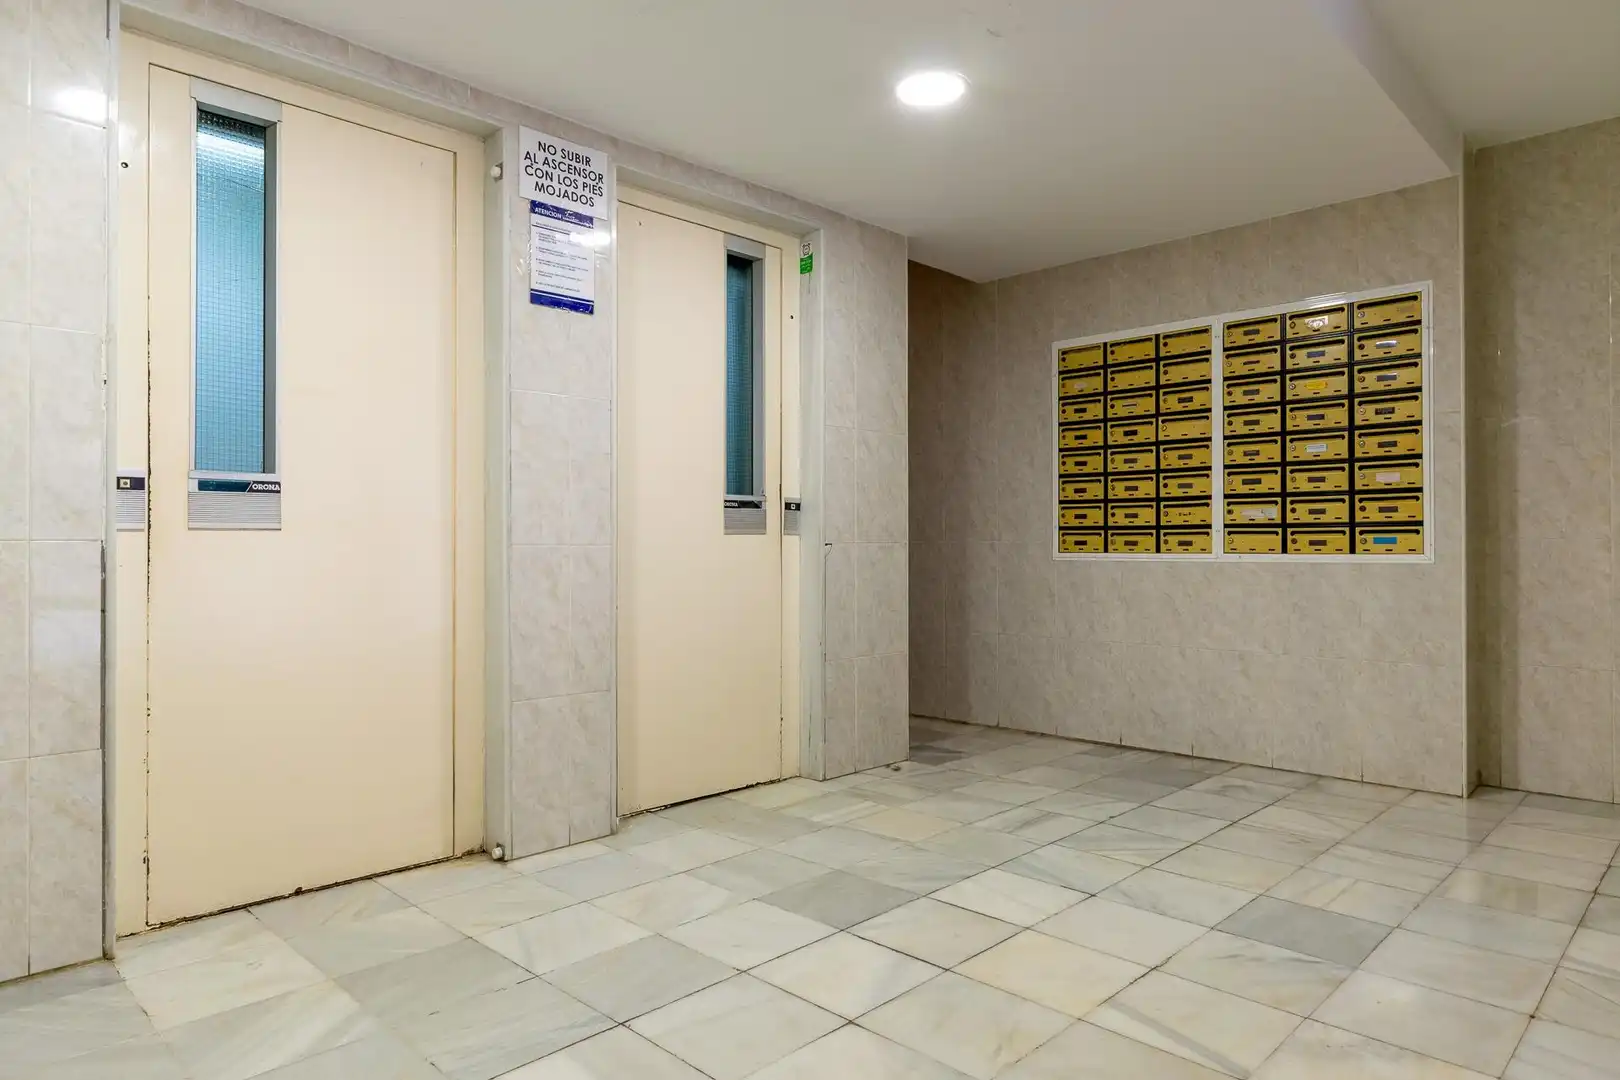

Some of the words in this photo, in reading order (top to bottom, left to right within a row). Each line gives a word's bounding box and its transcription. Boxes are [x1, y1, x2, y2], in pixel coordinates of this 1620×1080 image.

[524, 151, 539, 165] AL
[542, 156, 604, 184] ASCENSOR
[538, 141, 557, 156] NO
[560, 148, 591, 167] SUBIR
[524, 164, 554, 182] CON
[557, 173, 579, 190] LOS
[582, 181, 604, 197] PIES
[534, 181, 594, 207] MOJADOS
